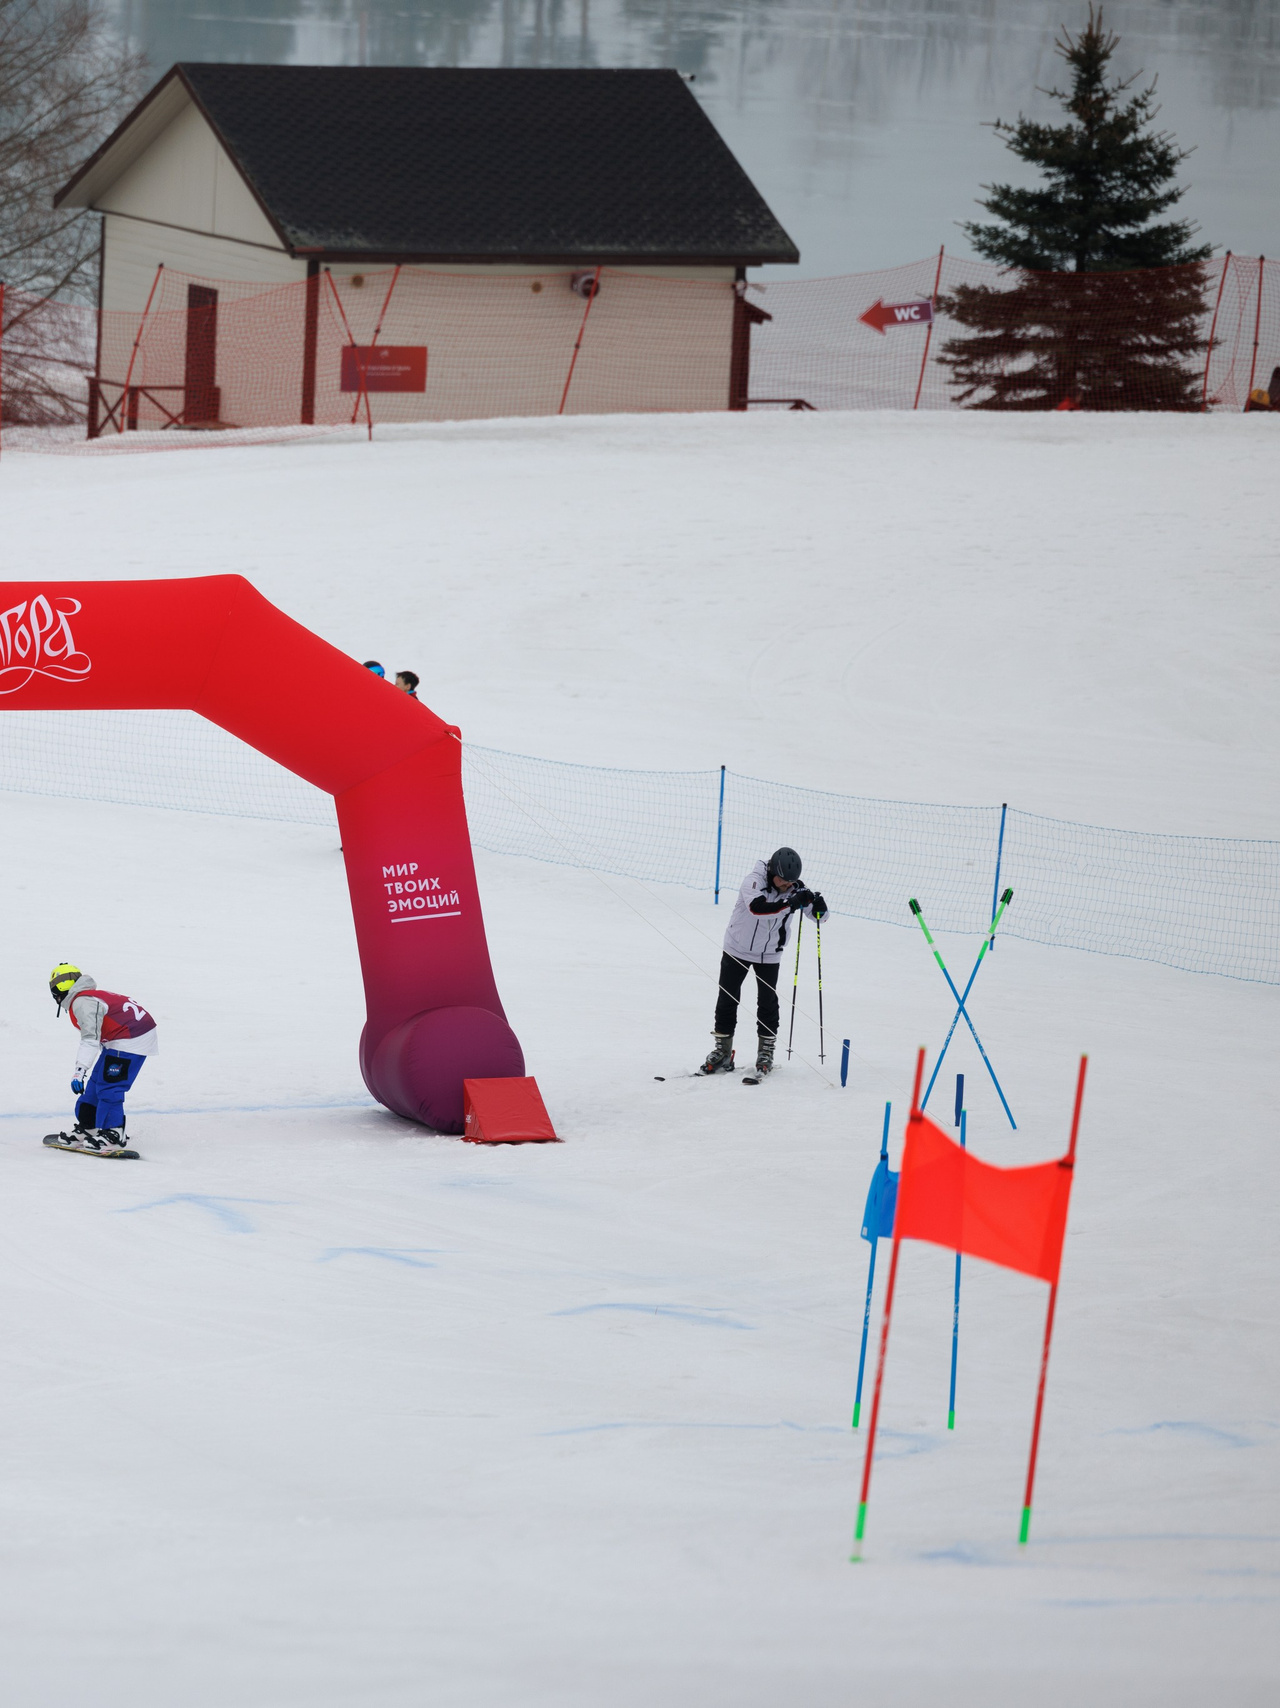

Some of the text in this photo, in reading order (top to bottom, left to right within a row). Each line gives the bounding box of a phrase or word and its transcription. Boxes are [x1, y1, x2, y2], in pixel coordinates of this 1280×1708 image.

[894, 306, 920, 321] WC
[382, 862, 419, 878] МИР
[384, 877, 441, 895] ТВОИХ
[387, 890, 460, 913] ЭМОЦИЙ
[123, 997, 147, 1021] 2
